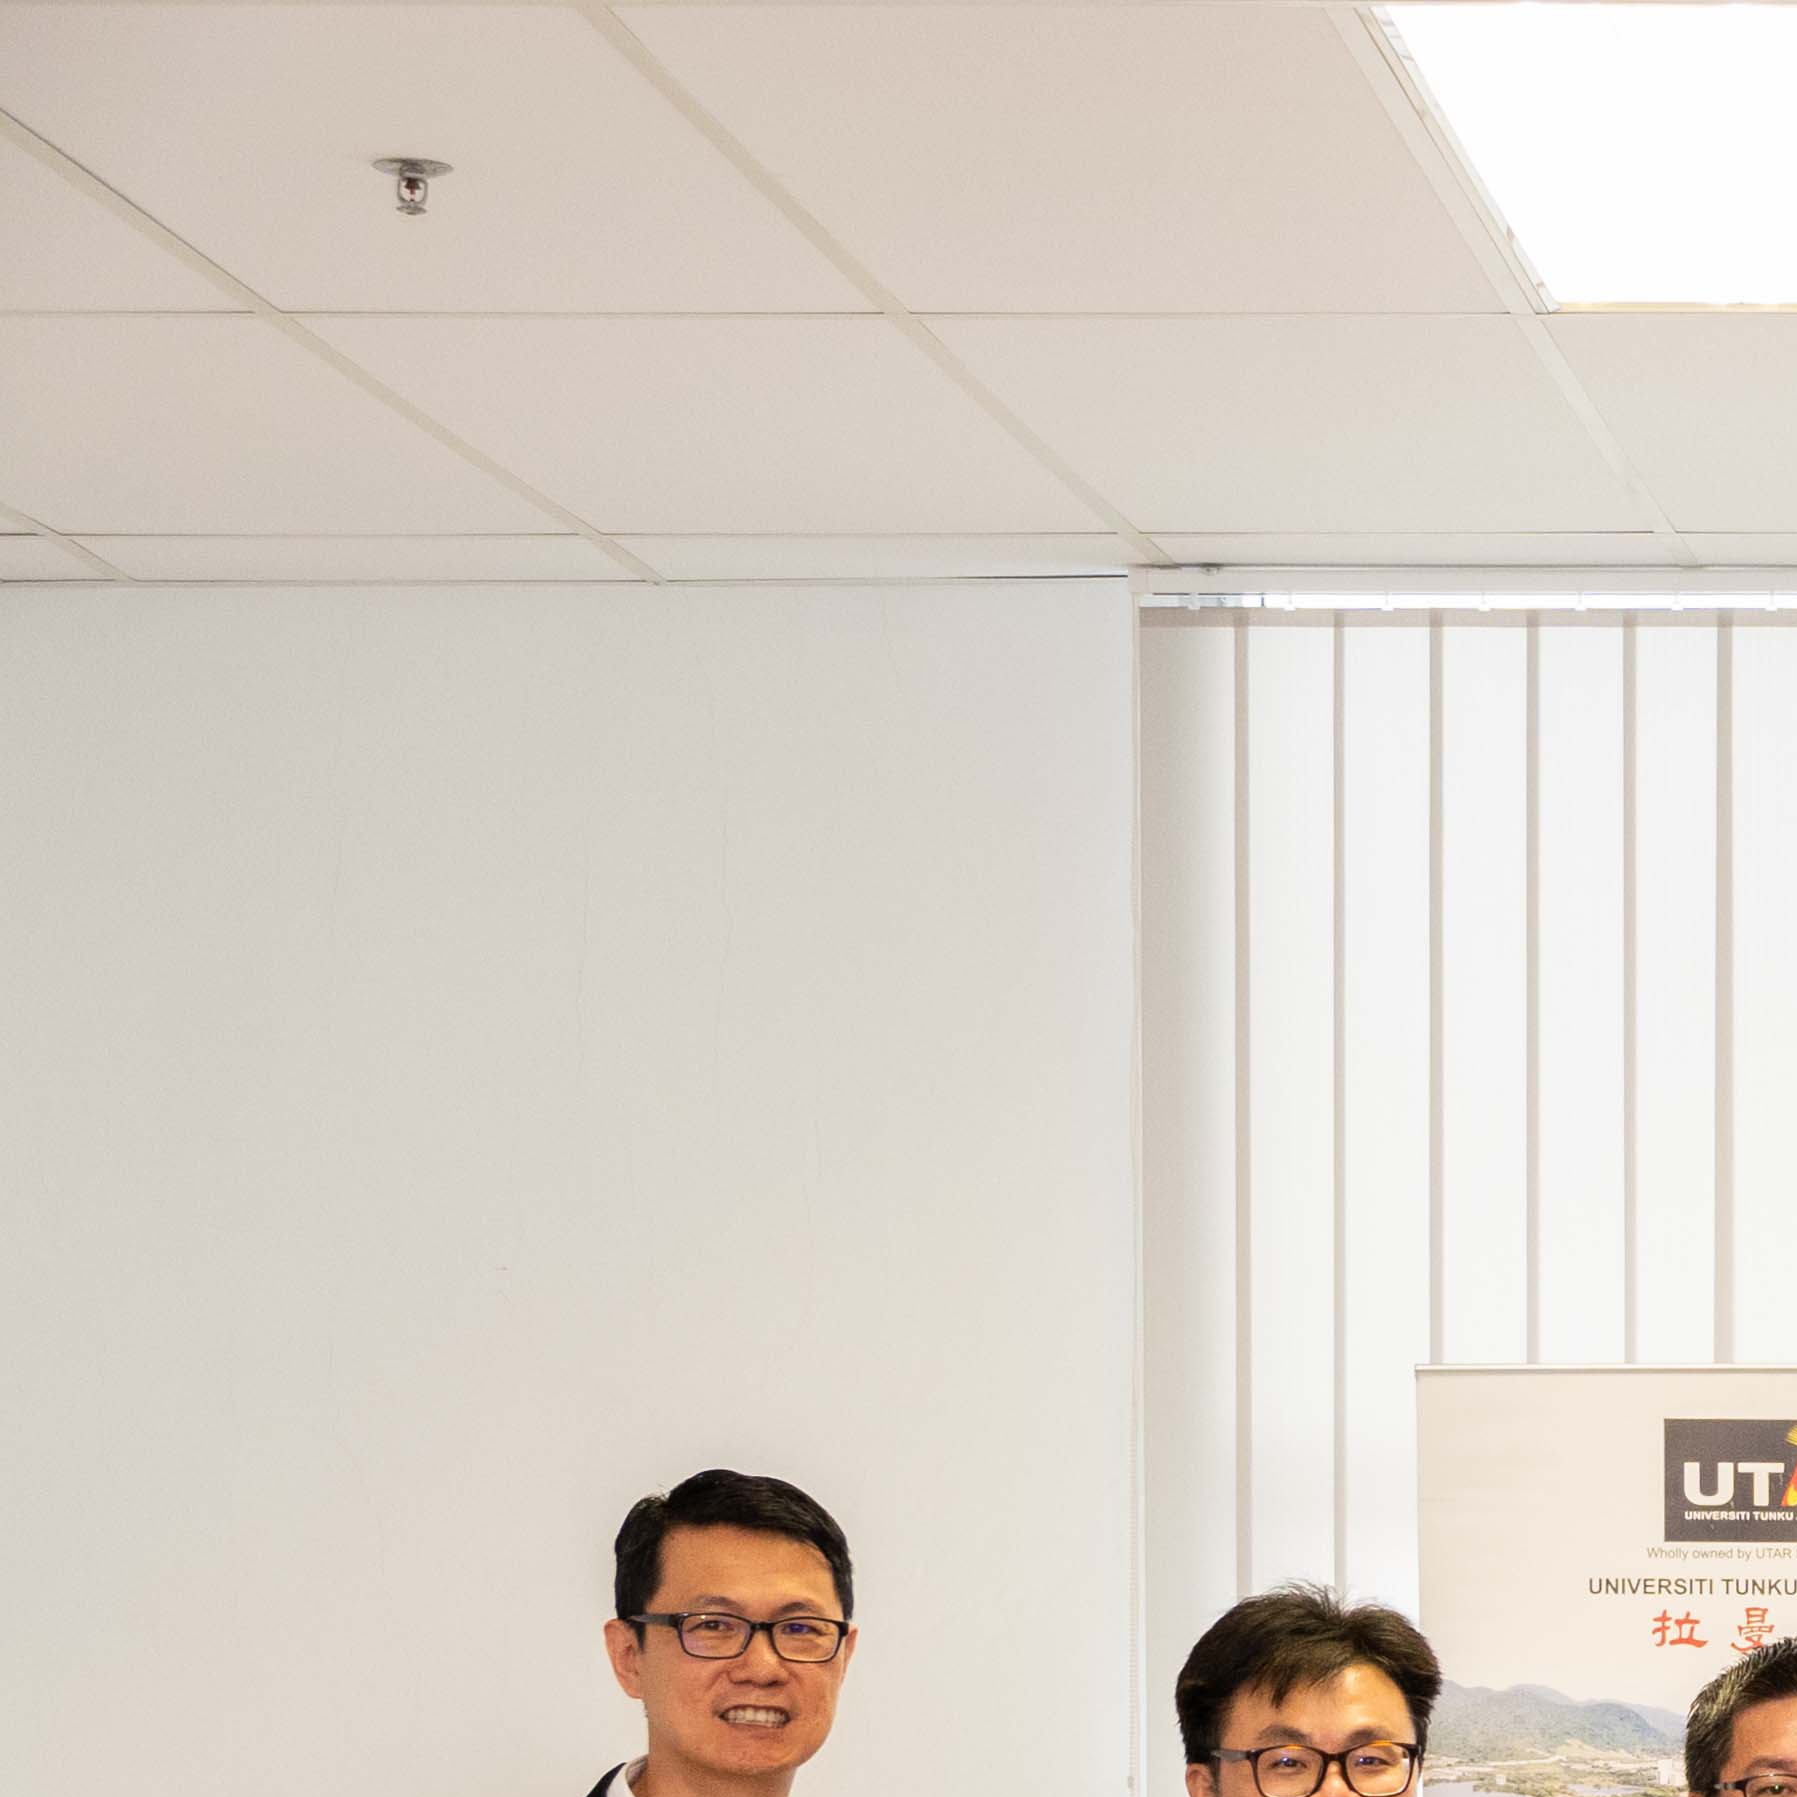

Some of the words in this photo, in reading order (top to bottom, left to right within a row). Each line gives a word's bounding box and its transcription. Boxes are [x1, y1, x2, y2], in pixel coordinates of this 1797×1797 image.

[1685, 1511, 1750, 1520] UNIVERSITI
[1753, 1511, 1793, 1521] TUNKU
[1646, 1547, 1688, 1560] Wholly
[1692, 1548, 1733, 1559] owned
[1737, 1548, 1751, 1562] by
[1756, 1548, 1792, 1559] UTAR
[1589, 1578, 1712, 1595] UNIVERSITI
[1721, 1579, 1797, 1595] TUNKU
